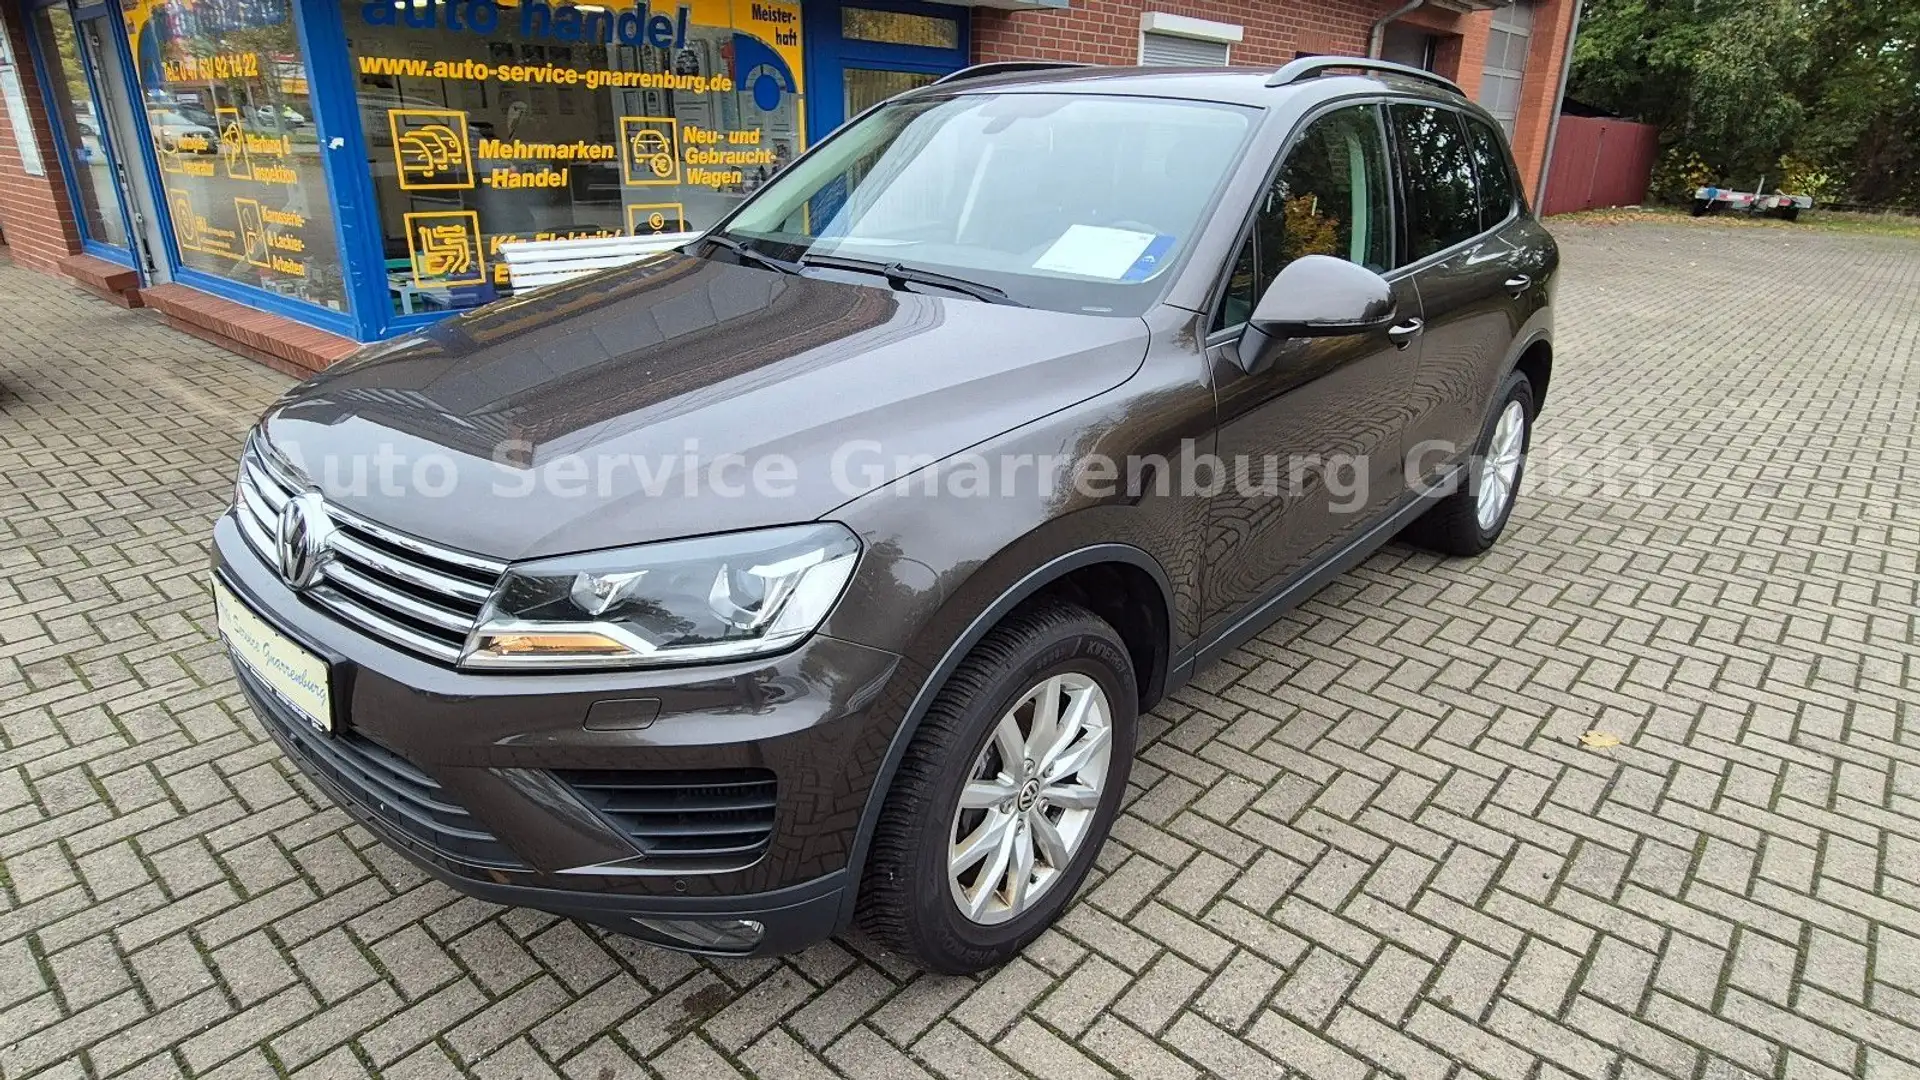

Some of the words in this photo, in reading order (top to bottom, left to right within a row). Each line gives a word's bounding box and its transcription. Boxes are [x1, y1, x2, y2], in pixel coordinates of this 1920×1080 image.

[362, 0, 498, 34] auto
[521, 0, 690, 49] handel
[751, 4, 797, 24] Meister-
[775, 26, 798, 47] haft
[358, 55, 733, 93] www.auto-service-gnarrenburg.de
[683, 126, 724, 144] Neu-
[728, 127, 760, 144] und
[478, 139, 614, 161] Mehrmarken
[685, 146, 777, 165] Gebraucht-
[482, 168, 568, 188] -Handel
[686, 167, 742, 188] Wagen
